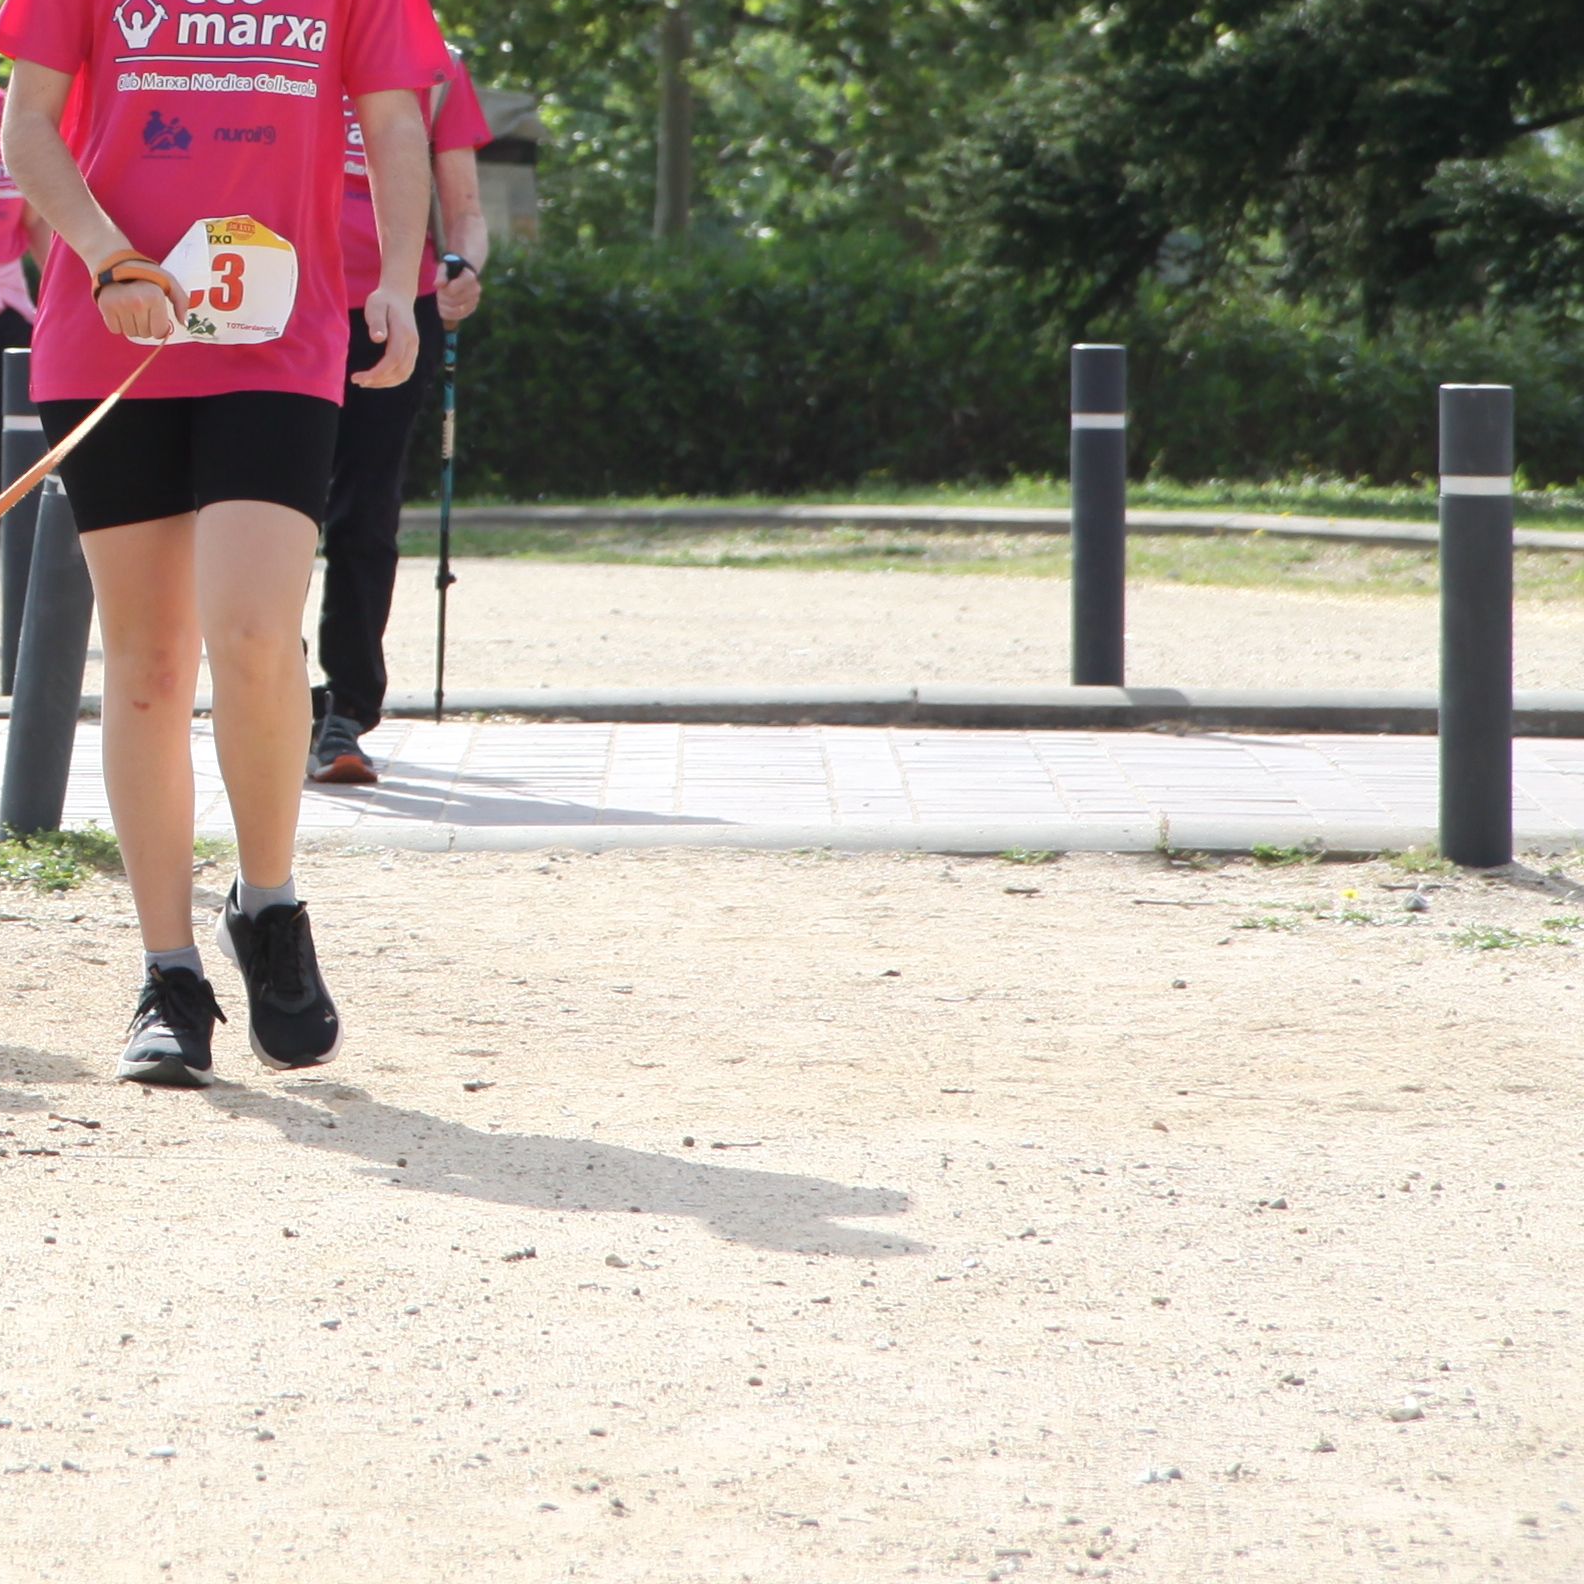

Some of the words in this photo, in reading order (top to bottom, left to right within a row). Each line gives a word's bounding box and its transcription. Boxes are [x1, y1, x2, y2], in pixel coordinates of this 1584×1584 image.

[177, 12, 328, 52] marxa
[142, 73, 190, 91] Marxa
[191, 74, 253, 92] Nòrdica
[254, 74, 317, 98] Collserola
